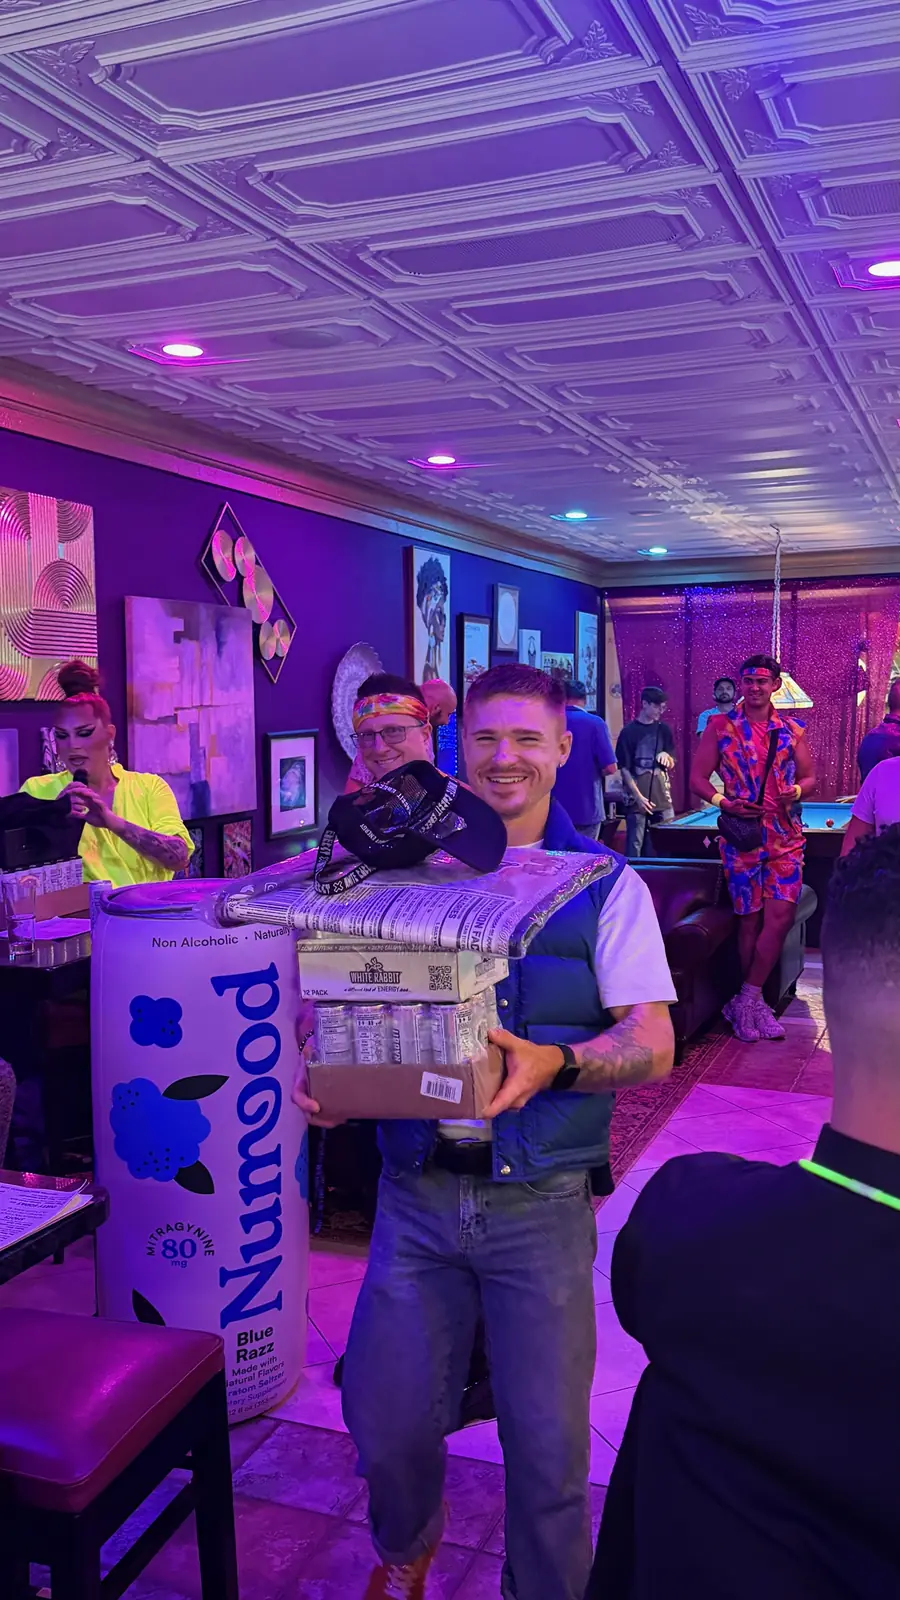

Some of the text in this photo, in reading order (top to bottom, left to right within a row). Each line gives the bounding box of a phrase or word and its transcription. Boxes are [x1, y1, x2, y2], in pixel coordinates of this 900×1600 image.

[152, 926, 291, 948] Non Alcoholic Naturally
[471, 930, 481, 951] FAC
[351, 972, 400, 983] WHITE RABBIT
[210, 962, 283, 1330] Numood
[146, 1222, 215, 1256] MITRAGYNINE
[161, 1238, 197, 1259] 80
[171, 1260, 188, 1269] mg
[237, 1326, 274, 1347] Blue
[236, 1342, 275, 1364] Razz
[232, 1355, 278, 1377] Made with
[258, 1360, 285, 1378] Flavors
[227, 1384, 257, 1397] ratom
[258, 1371, 285, 1389] Seltzer
